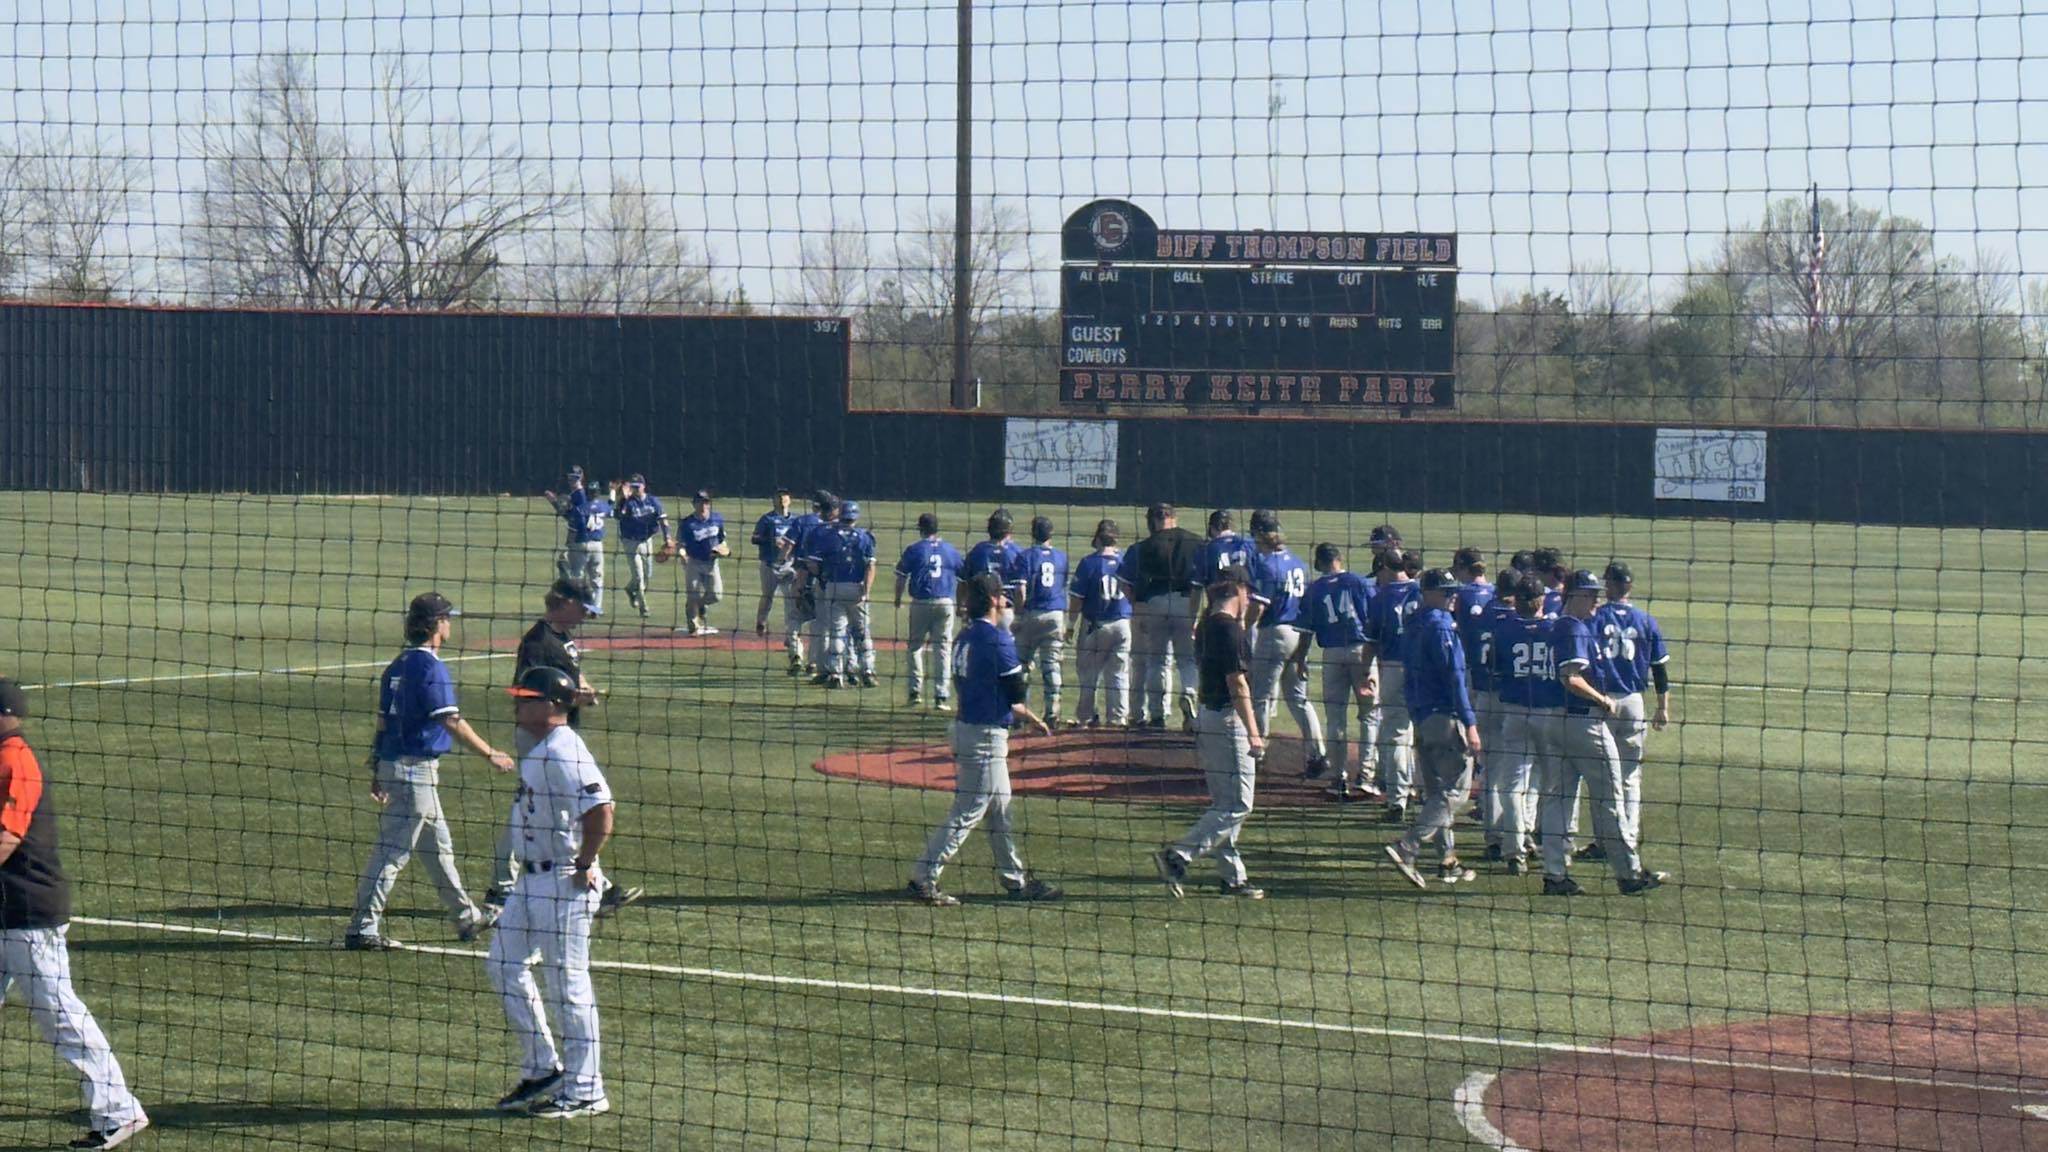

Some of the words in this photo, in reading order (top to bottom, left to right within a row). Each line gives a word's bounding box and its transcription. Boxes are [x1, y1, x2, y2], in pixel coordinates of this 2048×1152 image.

[1226, 236, 1366, 260] THOMPSON
[1376, 238, 1451, 262] FIELD
[1173, 271, 1204, 284] BALL
[1251, 272, 1294, 285] STRIKE
[1338, 273, 1363, 286] OUT
[813, 320, 840, 333] 397
[1156, 315, 1163, 325] 2
[1174, 315, 1180, 326] 3
[1193, 315, 1200, 326] 4
[1210, 315, 1217, 327] 5
[1227, 315, 1234, 327] 6
[1247, 316, 1253, 327] 7
[1263, 316, 1270, 328] 8
[1280, 317, 1287, 328] 9
[1072, 326, 1122, 342] GUEST
[1067, 347, 1126, 364] COWBOYS
[1073, 372, 1191, 400] PERRY
[1210, 375, 1321, 401] KEITH
[1339, 376, 1435, 404] PARK
[587, 512, 604, 531] 45
[929, 554, 942, 578] 3
[1041, 561, 1055, 588] 8
